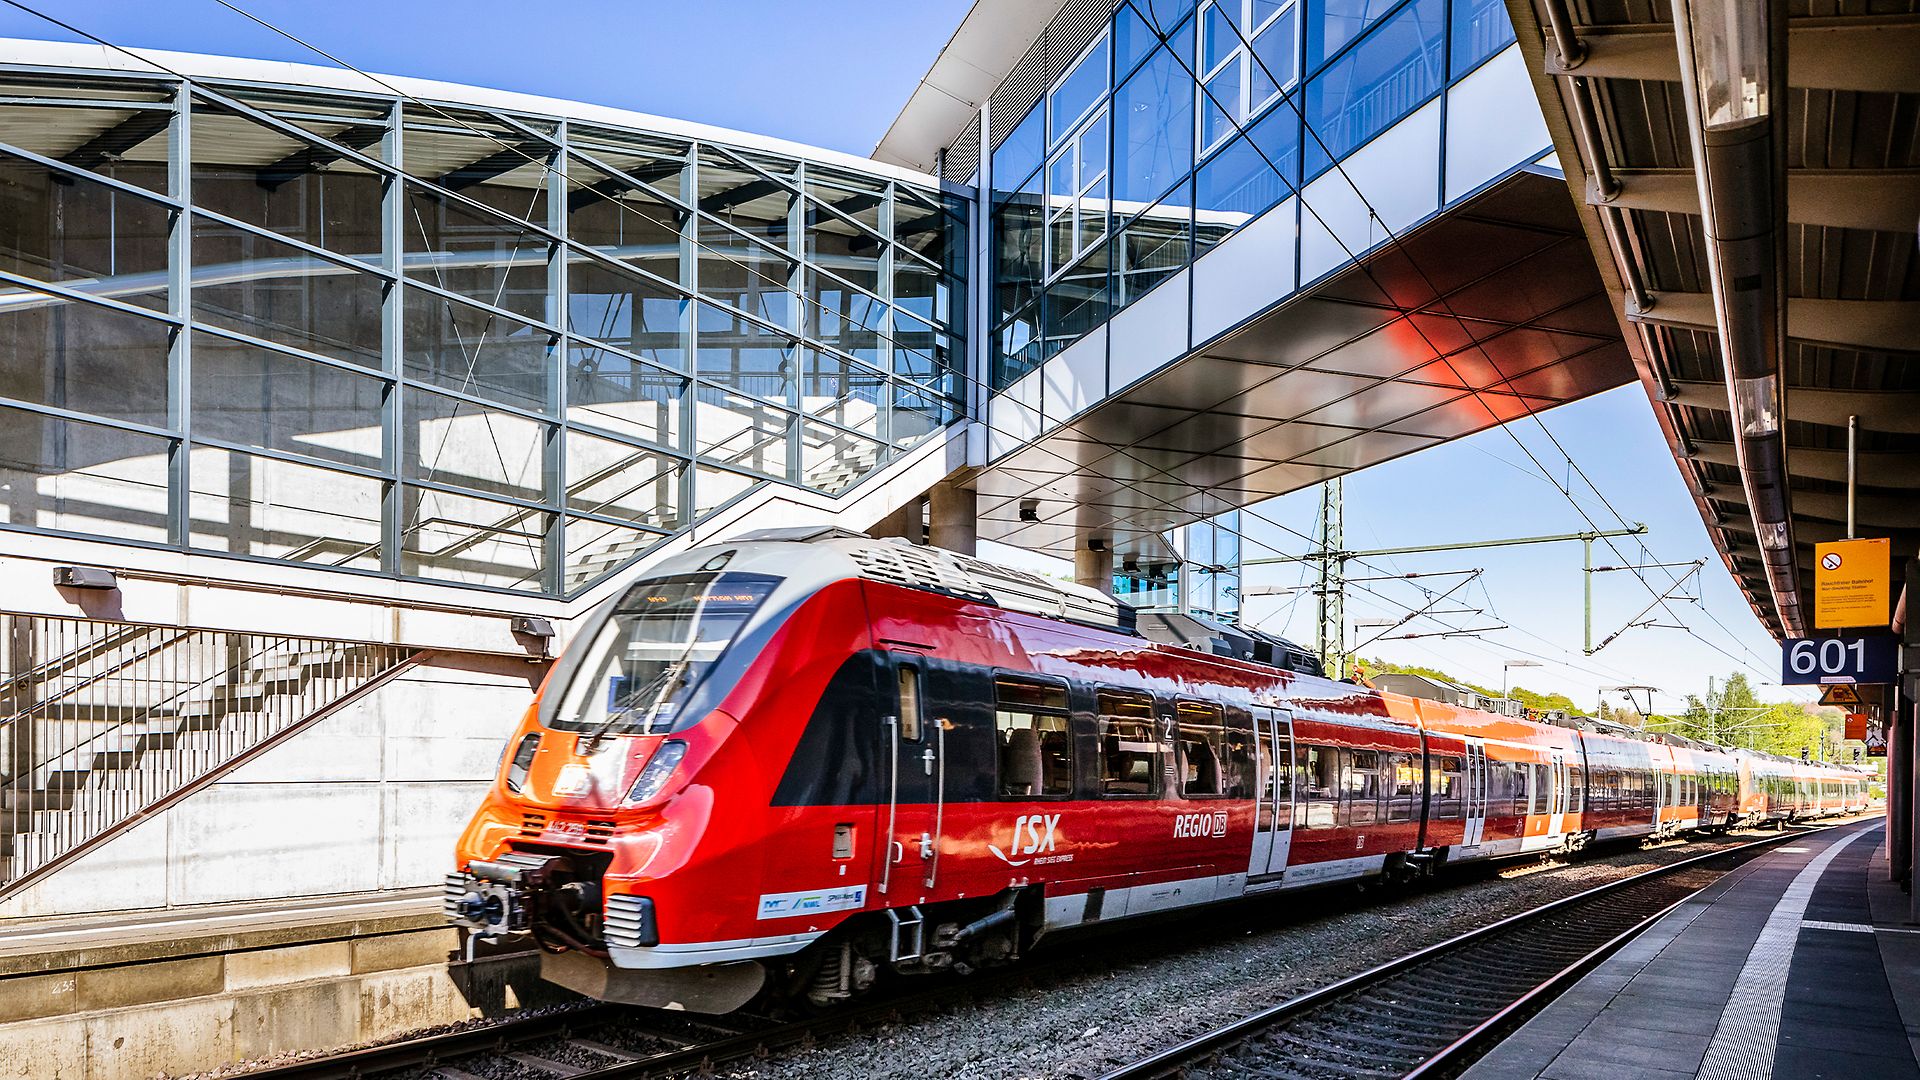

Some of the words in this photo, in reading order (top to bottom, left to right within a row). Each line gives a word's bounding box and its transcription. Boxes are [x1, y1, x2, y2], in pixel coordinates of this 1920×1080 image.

[1790, 639, 1864, 674] 601
[1164, 716, 1172, 739] 2
[1173, 813, 1212, 838] REGIO
[1213, 814, 1227, 834] DB
